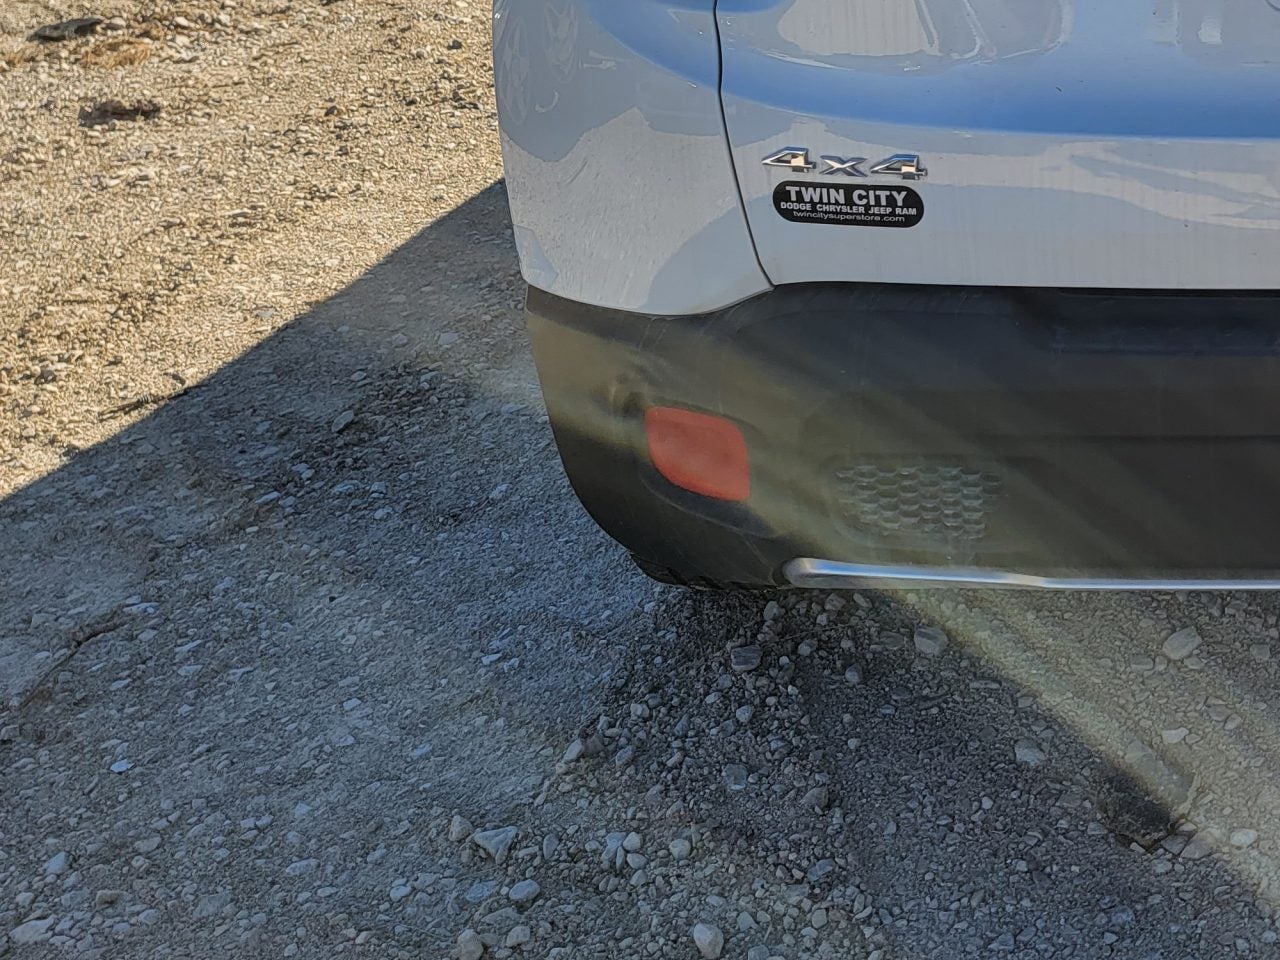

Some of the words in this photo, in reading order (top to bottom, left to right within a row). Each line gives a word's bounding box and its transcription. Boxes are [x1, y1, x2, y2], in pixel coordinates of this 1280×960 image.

[785, 186, 845, 205] TWIN
[852, 189, 908, 207] CITY
[780, 201, 812, 211] DODGE
[816, 203, 865, 214] CHRYSLER
[868, 206, 892, 215] JEEP
[895, 207, 917, 216] RAM
[793, 210, 905, 223] twincitysuperstore.com
